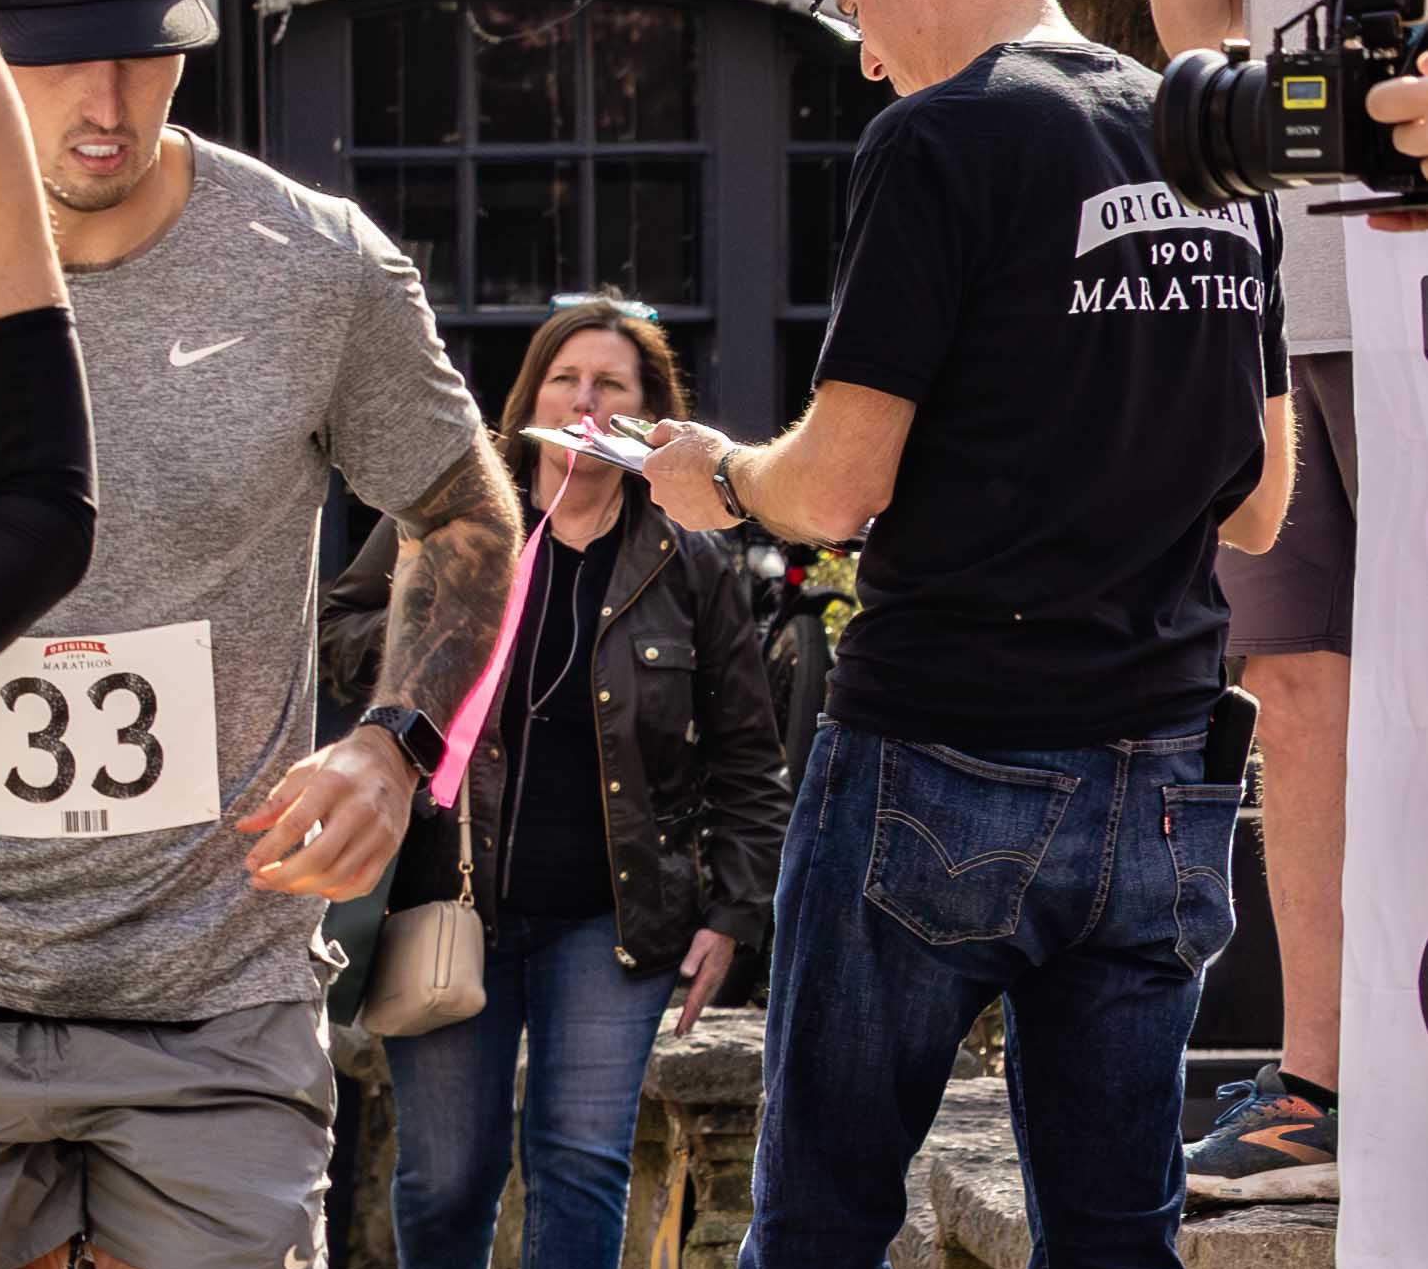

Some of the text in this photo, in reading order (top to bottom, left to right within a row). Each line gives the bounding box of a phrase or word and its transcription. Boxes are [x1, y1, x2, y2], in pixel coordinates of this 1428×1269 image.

[1285, 125, 1321, 136] SONY
[1150, 239, 1213, 265] 1908
[49, 641, 101, 653] ORIGINAL
[42, 659, 113, 670] MARATHON
[0, 672, 164, 803] 33
